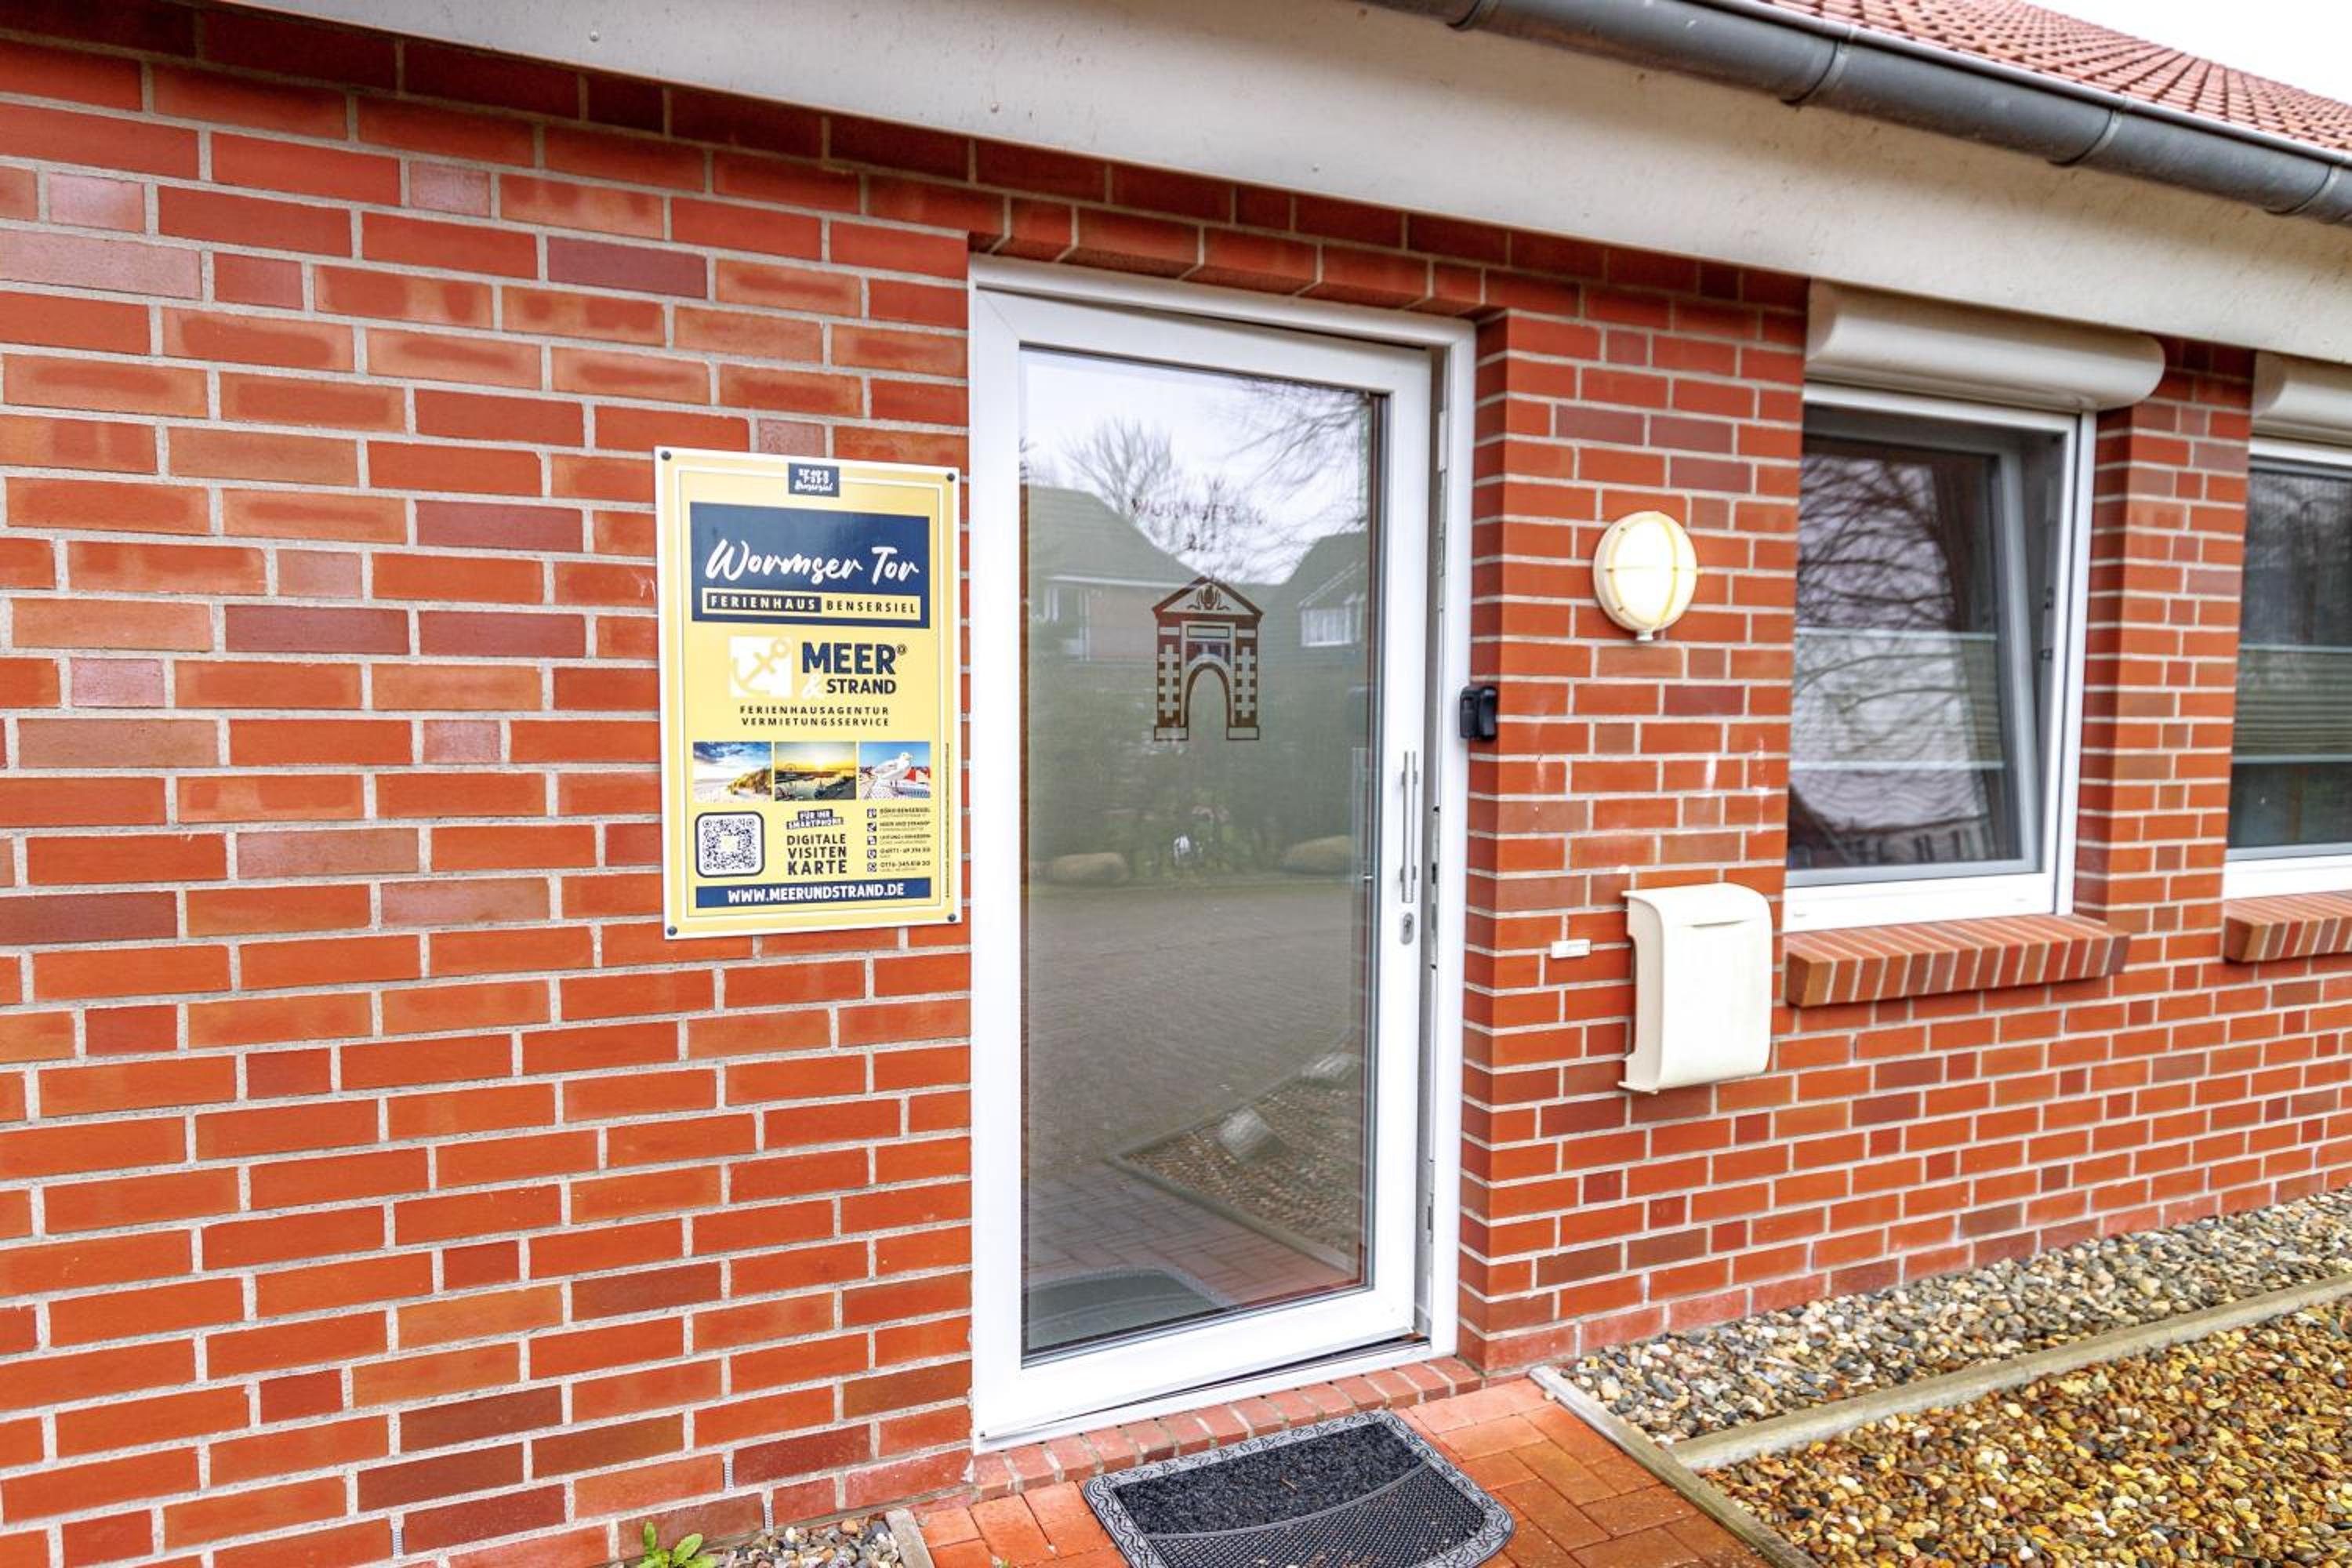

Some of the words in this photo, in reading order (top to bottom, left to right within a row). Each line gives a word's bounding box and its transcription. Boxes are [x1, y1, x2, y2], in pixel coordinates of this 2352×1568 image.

[705, 538, 862, 584] Wormser
[871, 546, 920, 586] Tor
[710, 594, 816, 611] FERIENHAUS
[826, 599, 916, 614] BENSERSIEL
[826, 678, 897, 695] STRAND
[739, 705, 889, 715] FERIENHAUSAGENTUR
[741, 717, 889, 727] VERMIETUNGSSERVICE
[786, 833, 846, 846] DIGITALE
[788, 846, 847, 859] VISITEN
[787, 859, 848, 876] KARTE
[727, 882, 905, 904] WWW.MEERUNDSTRAND.DE
